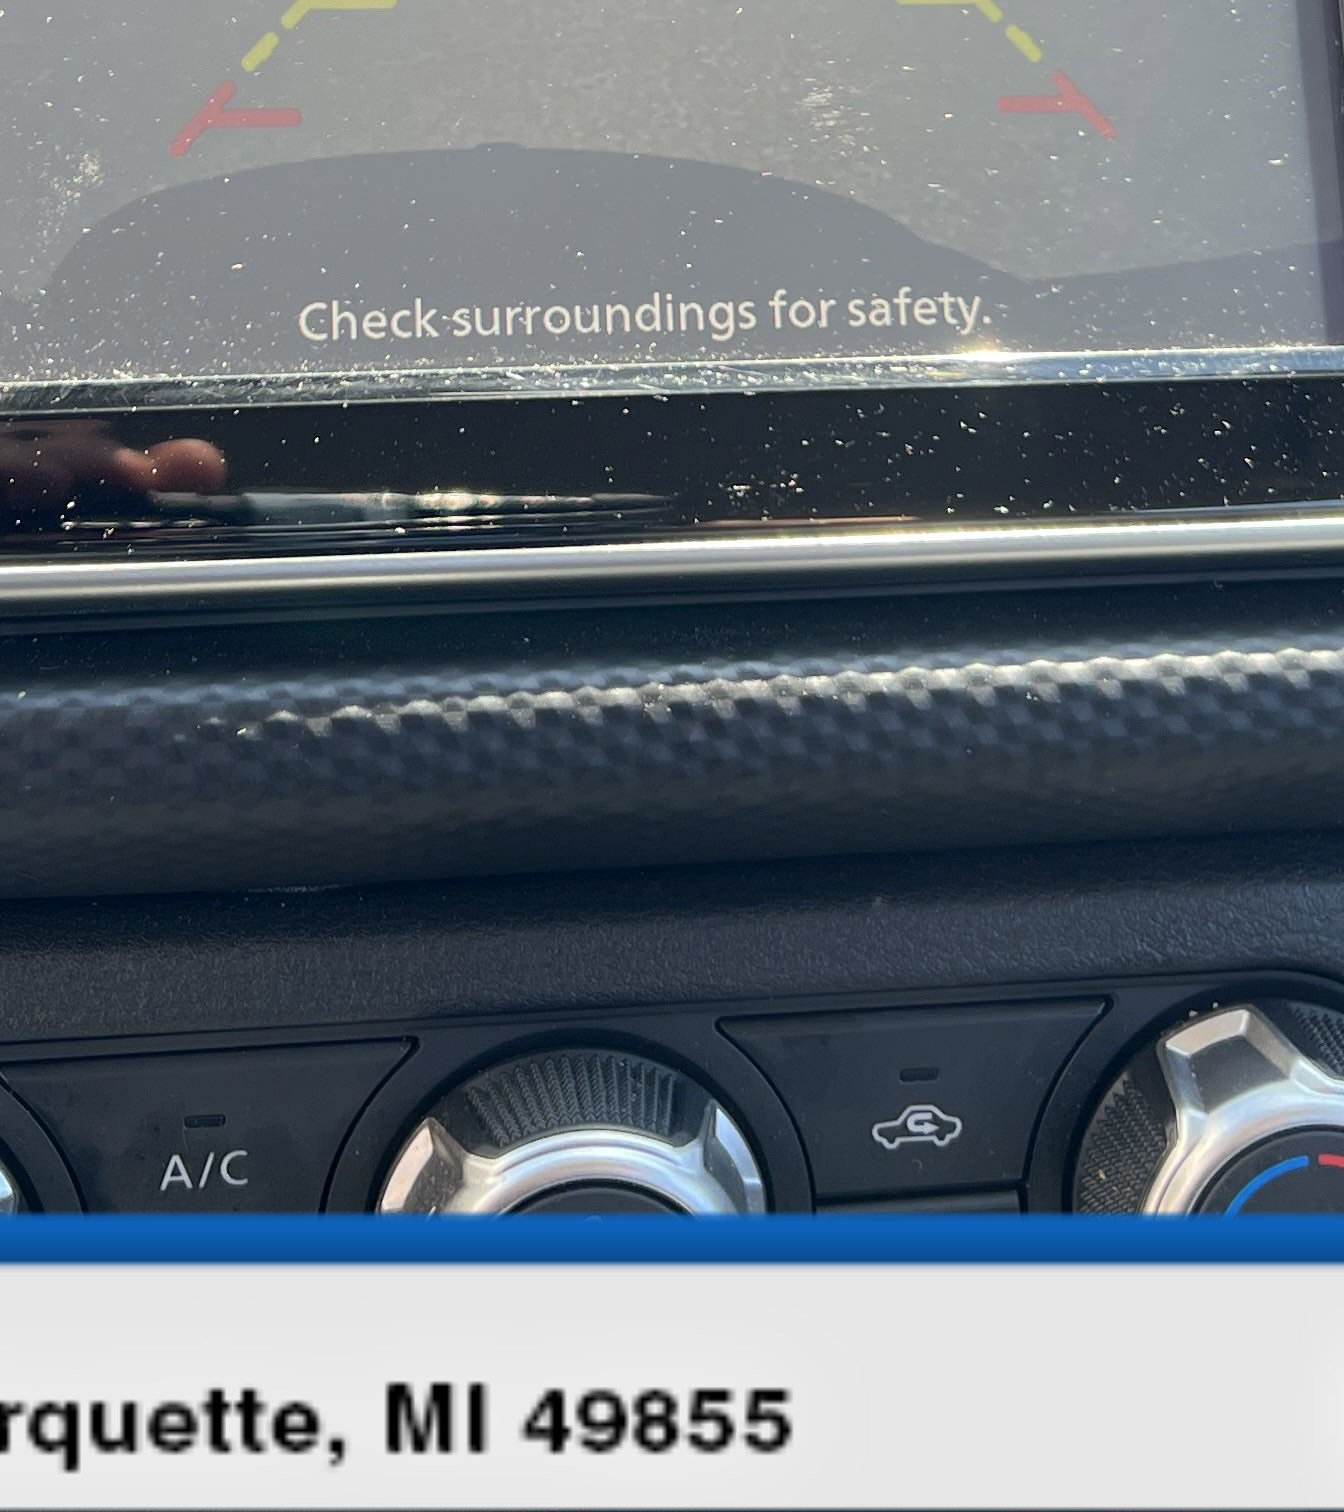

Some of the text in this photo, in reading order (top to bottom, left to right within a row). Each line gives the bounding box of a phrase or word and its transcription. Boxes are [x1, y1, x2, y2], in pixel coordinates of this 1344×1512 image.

[298, 286, 993, 341] Check surroundings for safety.
[159, 1149, 249, 1191] A/C
